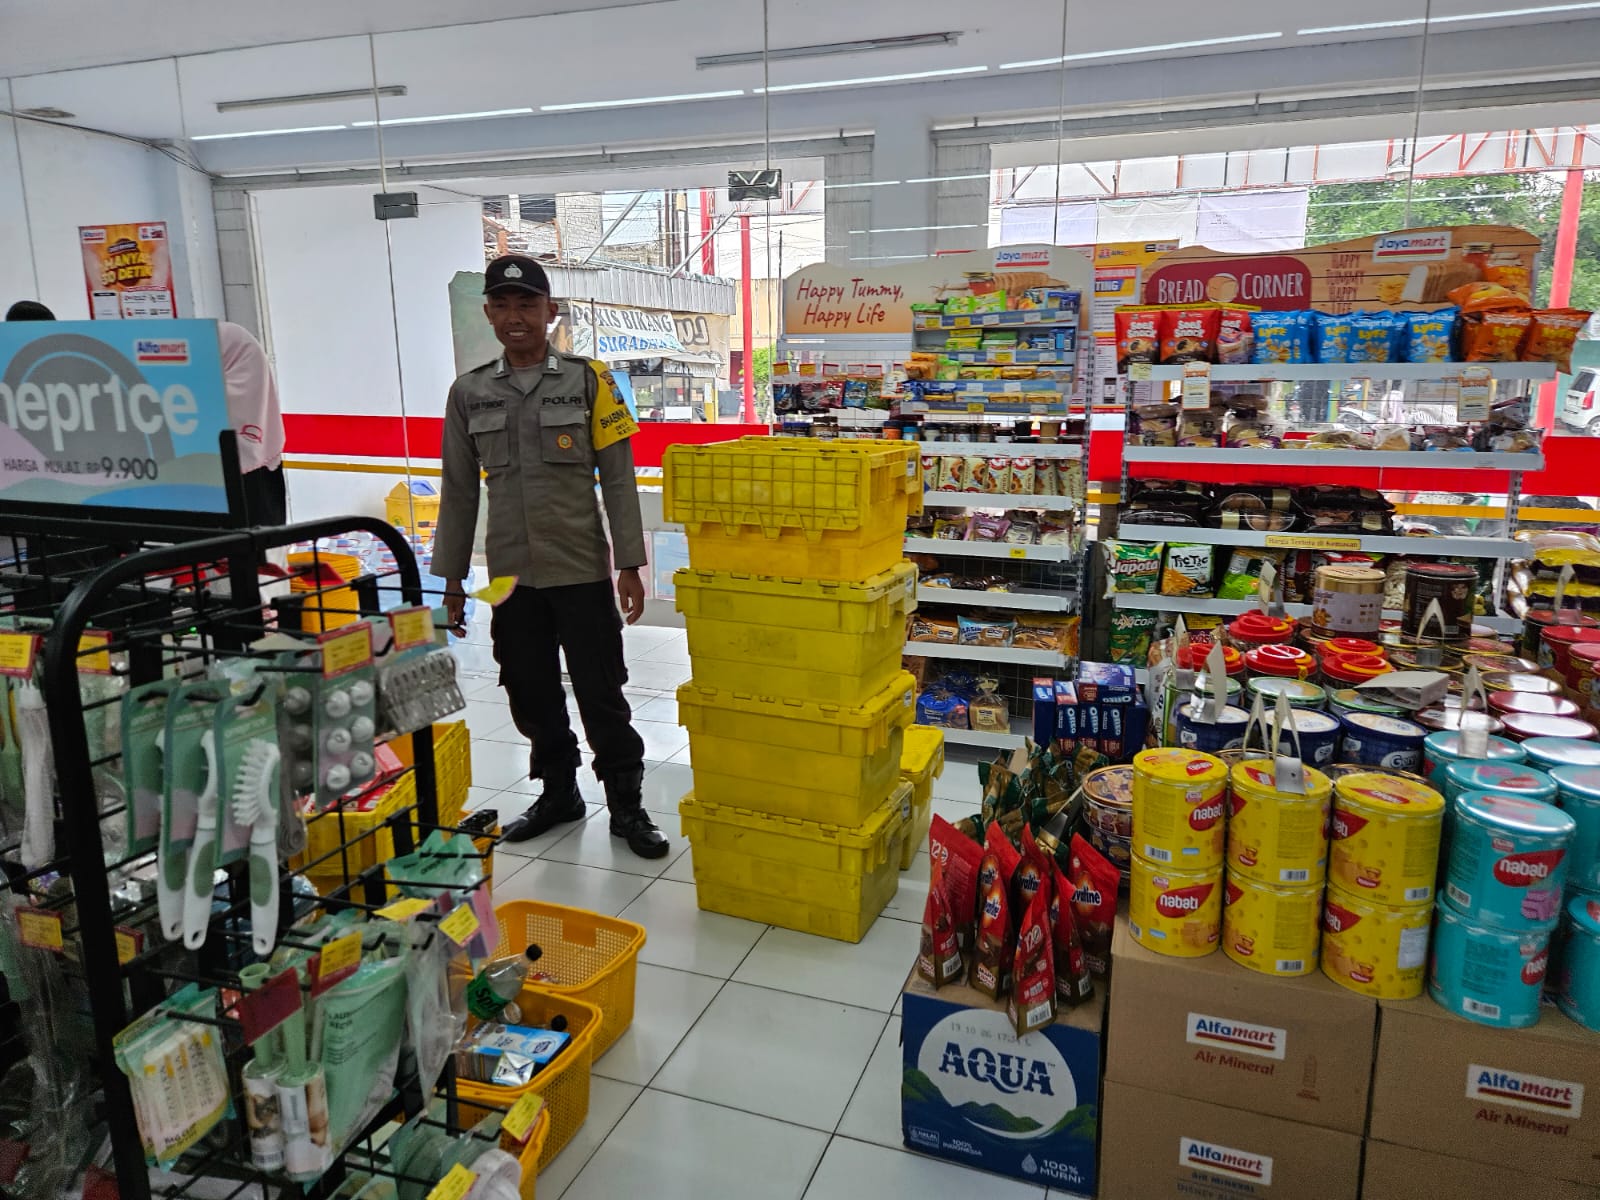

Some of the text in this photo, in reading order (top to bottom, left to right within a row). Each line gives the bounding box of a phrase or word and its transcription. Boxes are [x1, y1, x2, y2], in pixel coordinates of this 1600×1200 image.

[1379, 236, 1446, 250] Jayamart
[995, 250, 1049, 262] Jayamart
[796, 278, 904, 300] Happy Tummy,
[1158, 272, 1304, 304] BREAD CORNER
[803, 302, 885, 328] Happy Life
[137, 341, 187, 355] Alfamart
[541, 396, 583, 406] POLRI
[3, 459, 39, 473] HARGA
[45, 460, 80, 474] MULAI
[1114, 559, 1160, 575] Japota
[1500, 857, 1549, 878] nabati
[1159, 894, 1199, 910] nabati
[1196, 1018, 1277, 1044] Alfamart
[939, 1041, 1055, 1096] AQUA
[1194, 1050, 1275, 1076] Air Mineral
[1478, 1071, 1574, 1100] Alfamart
[1476, 1108, 1569, 1136] Air Mineral
[1043, 1159, 1079, 1176] 100%
[1188, 1143, 1263, 1171] Alfamart
[1040, 1166, 1082, 1184] MURNI
